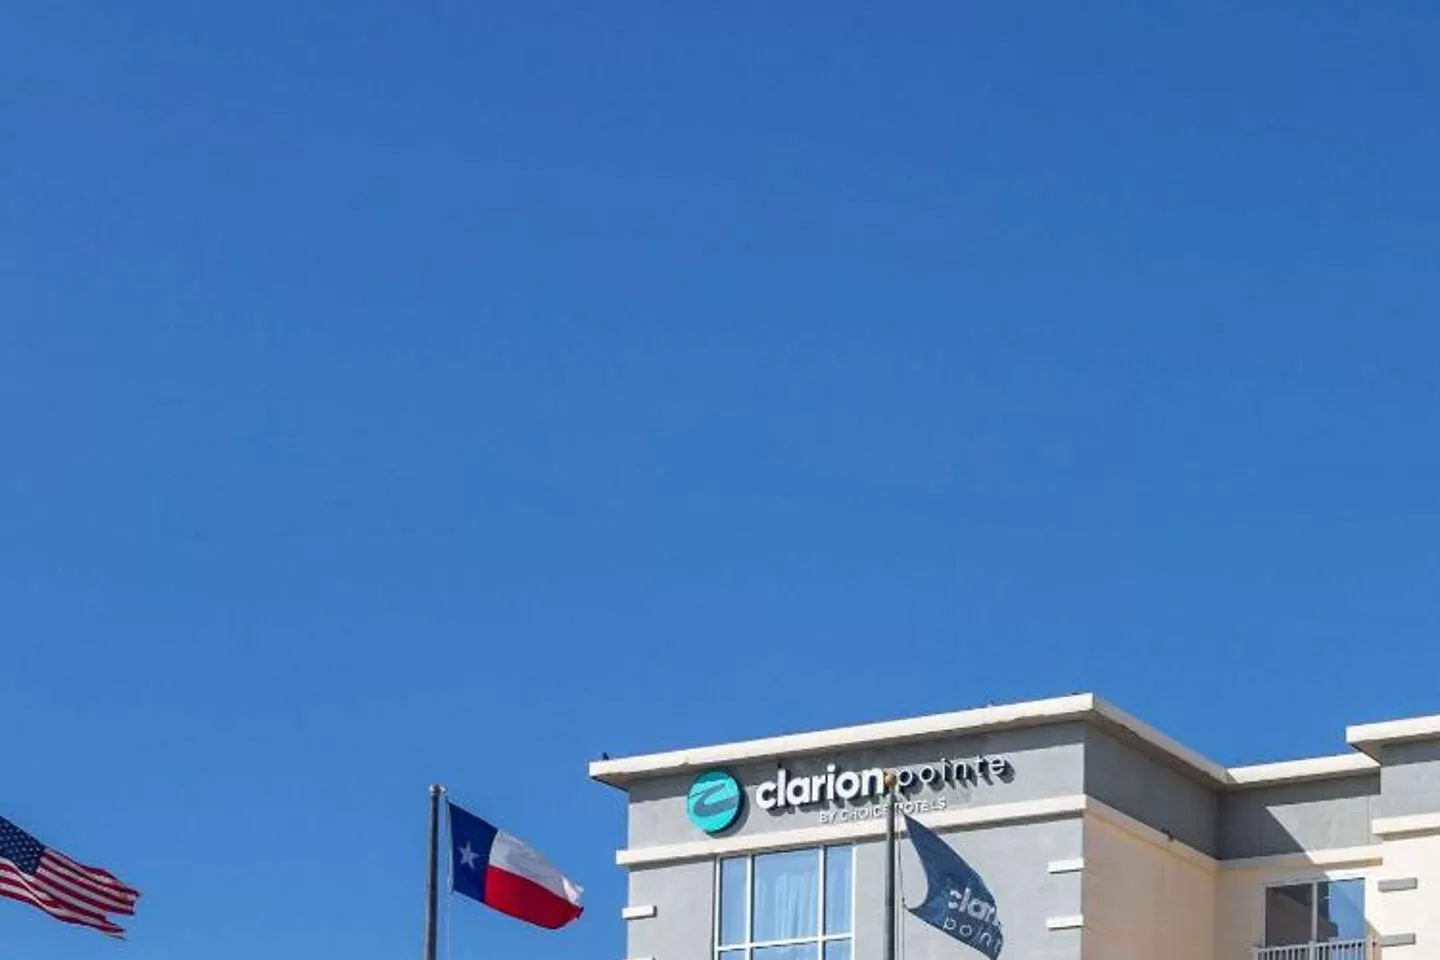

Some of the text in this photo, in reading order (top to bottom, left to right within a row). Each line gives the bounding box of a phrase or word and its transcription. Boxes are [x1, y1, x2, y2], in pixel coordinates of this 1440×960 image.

[755, 755, 1005, 809] clarion pointe
[818, 811, 836, 823] BY
[840, 806, 889, 822] CHOICE
